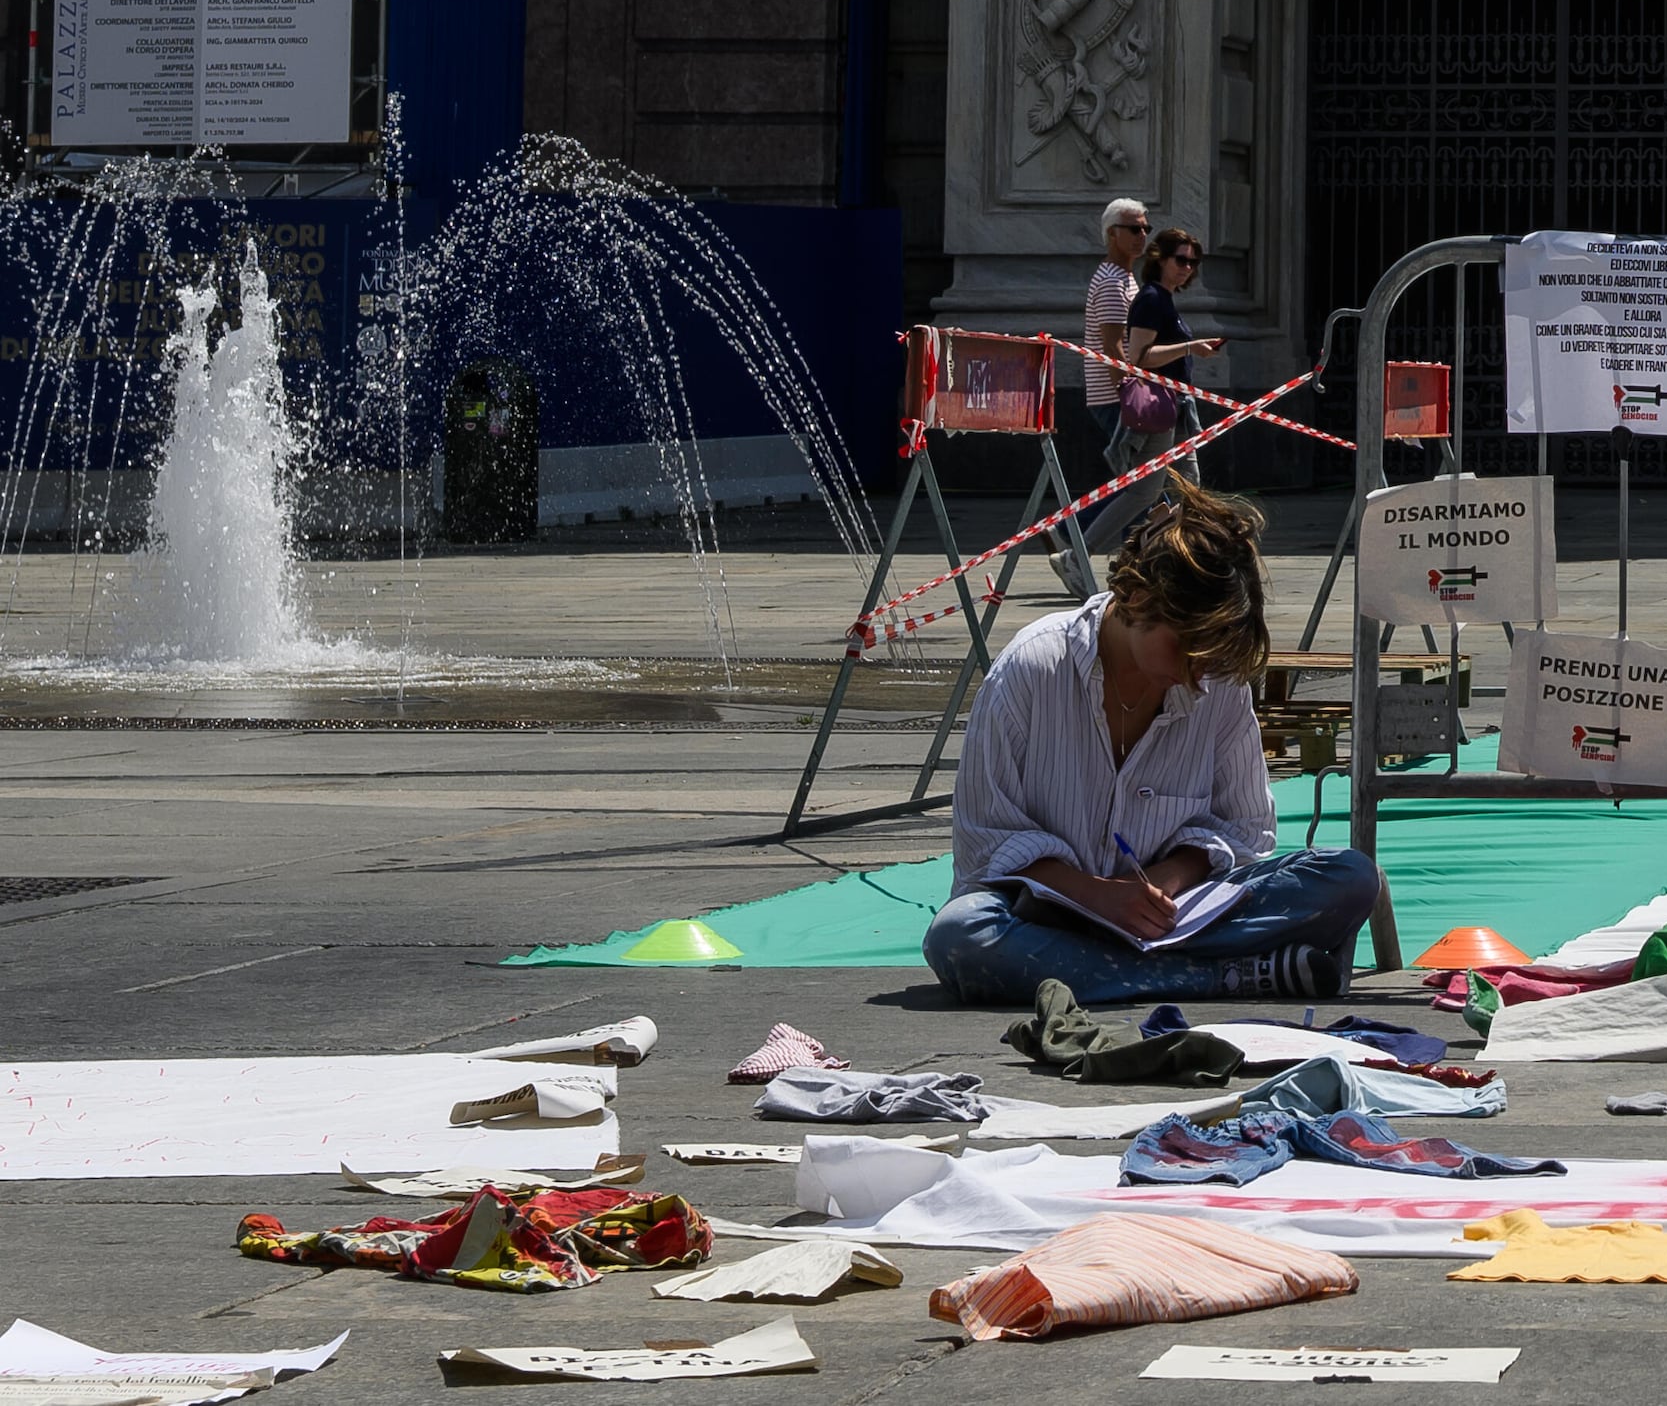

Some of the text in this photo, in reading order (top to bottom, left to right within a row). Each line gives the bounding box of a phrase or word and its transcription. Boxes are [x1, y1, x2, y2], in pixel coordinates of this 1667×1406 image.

[1587, 244, 1632, 254] DECIDETEVI
[1634, 245, 1639, 255] A
[1642, 245, 1658, 255] NON
[1611, 260, 1621, 270] ED
[1623, 261, 1650, 272] ECCOVI
[1539, 276, 1555, 287] NON
[1559, 276, 1585, 287] VOGLIO
[1588, 277, 1601, 288] CHE
[1604, 278, 1612, 288] LO
[1614, 278, 1660, 290] ABBATTIATE
[1664, 279, 1667, 290] O
[1581, 293, 1617, 304] SOLTANTO
[1620, 294, 1636, 305] NON
[1624, 310, 1662, 322] E ALLORA
[1536, 326, 1558, 337] COME
[1561, 326, 1571, 337] UN
[1574, 327, 1601, 338] GRANDE
[1605, 327, 1638, 339] COLOSSO
[1640, 328, 1652, 339] CUI
[1654, 329, 1666, 340] SIA
[1561, 343, 1570, 353] LO
[1573, 343, 1604, 354] VEDRETE
[1606, 344, 1652, 356] PRECIPITARE
[1600, 359, 1604, 370] E
[1605, 360, 1634, 371] CADERE
[1636, 360, 1643, 372] IN
[1621, 412, 1658, 420] GENOCIDE
[1384, 499, 1526, 523] DISARMIAMO
[1399, 529, 1510, 549] IL MONDO
[1540, 656, 1622, 681] PRENDI
[1543, 684, 1664, 712] POSIZIONE
[1580, 745, 1600, 753] STOP
[1580, 752, 1616, 762] GENOCIDE
